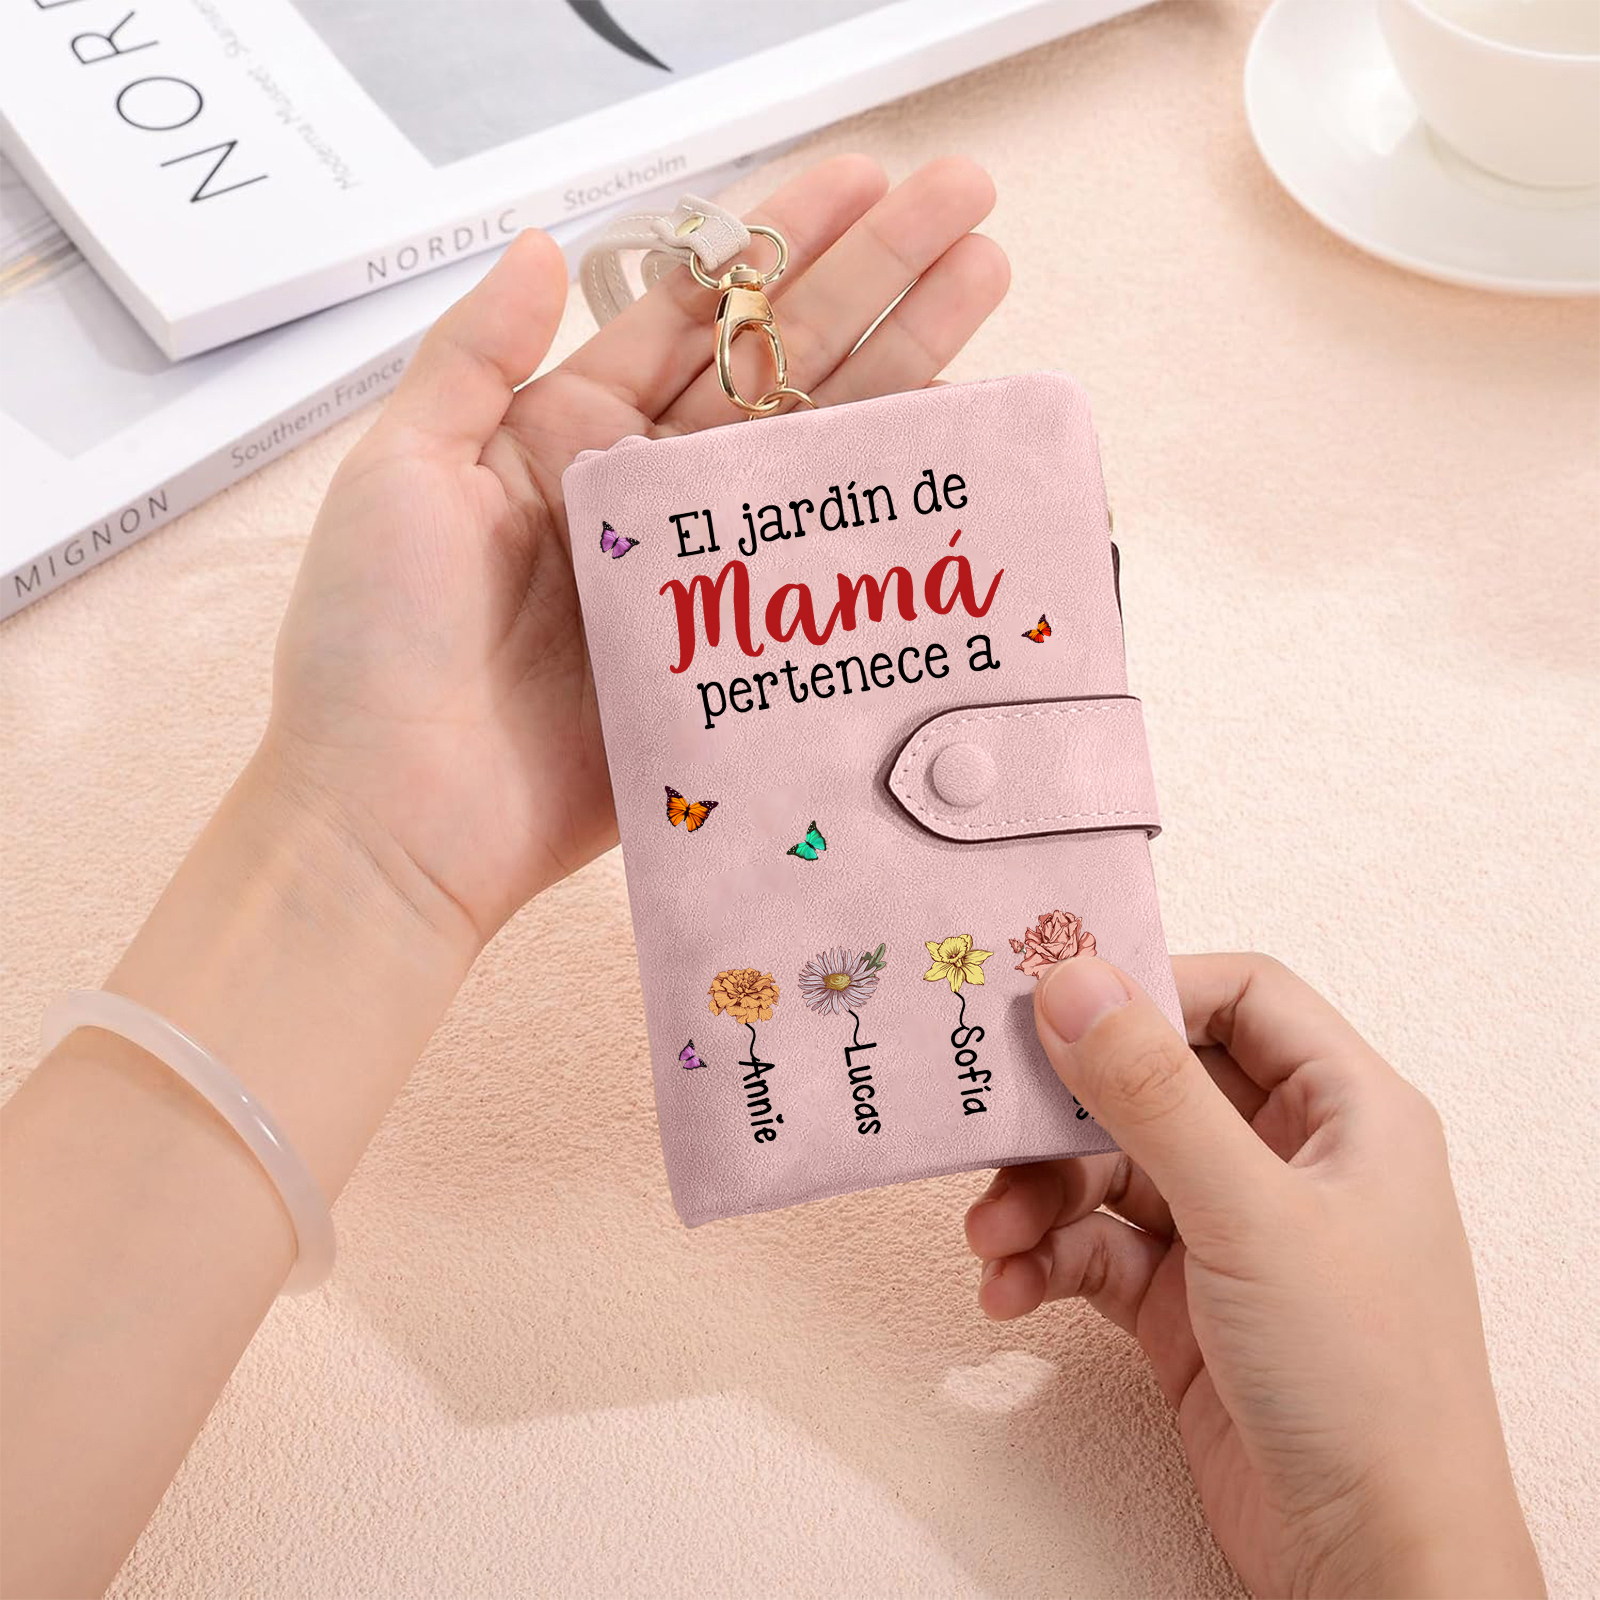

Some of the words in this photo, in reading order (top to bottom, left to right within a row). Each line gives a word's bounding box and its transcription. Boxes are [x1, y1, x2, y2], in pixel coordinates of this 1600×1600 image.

[34, 0, 269, 203] NOR
[366, 208, 516, 284] NORDIC
[563, 154, 687, 212] Stockholm
[14, 489, 169, 598] MIGNON
[231, 401, 331, 469] Southern
[334, 357, 404, 406] France
[669, 510, 721, 557] El
[738, 481, 898, 557] jardín
[913, 469, 968, 515] de
[659, 529, 1004, 674] Mamá
[696, 643, 949, 730] pertenece
[966, 634, 1001, 671] a
[738, 1057, 784, 1144] Annie
[844, 1042, 882, 1135] Lucas
[950, 1025, 992, 1116] Sofía
